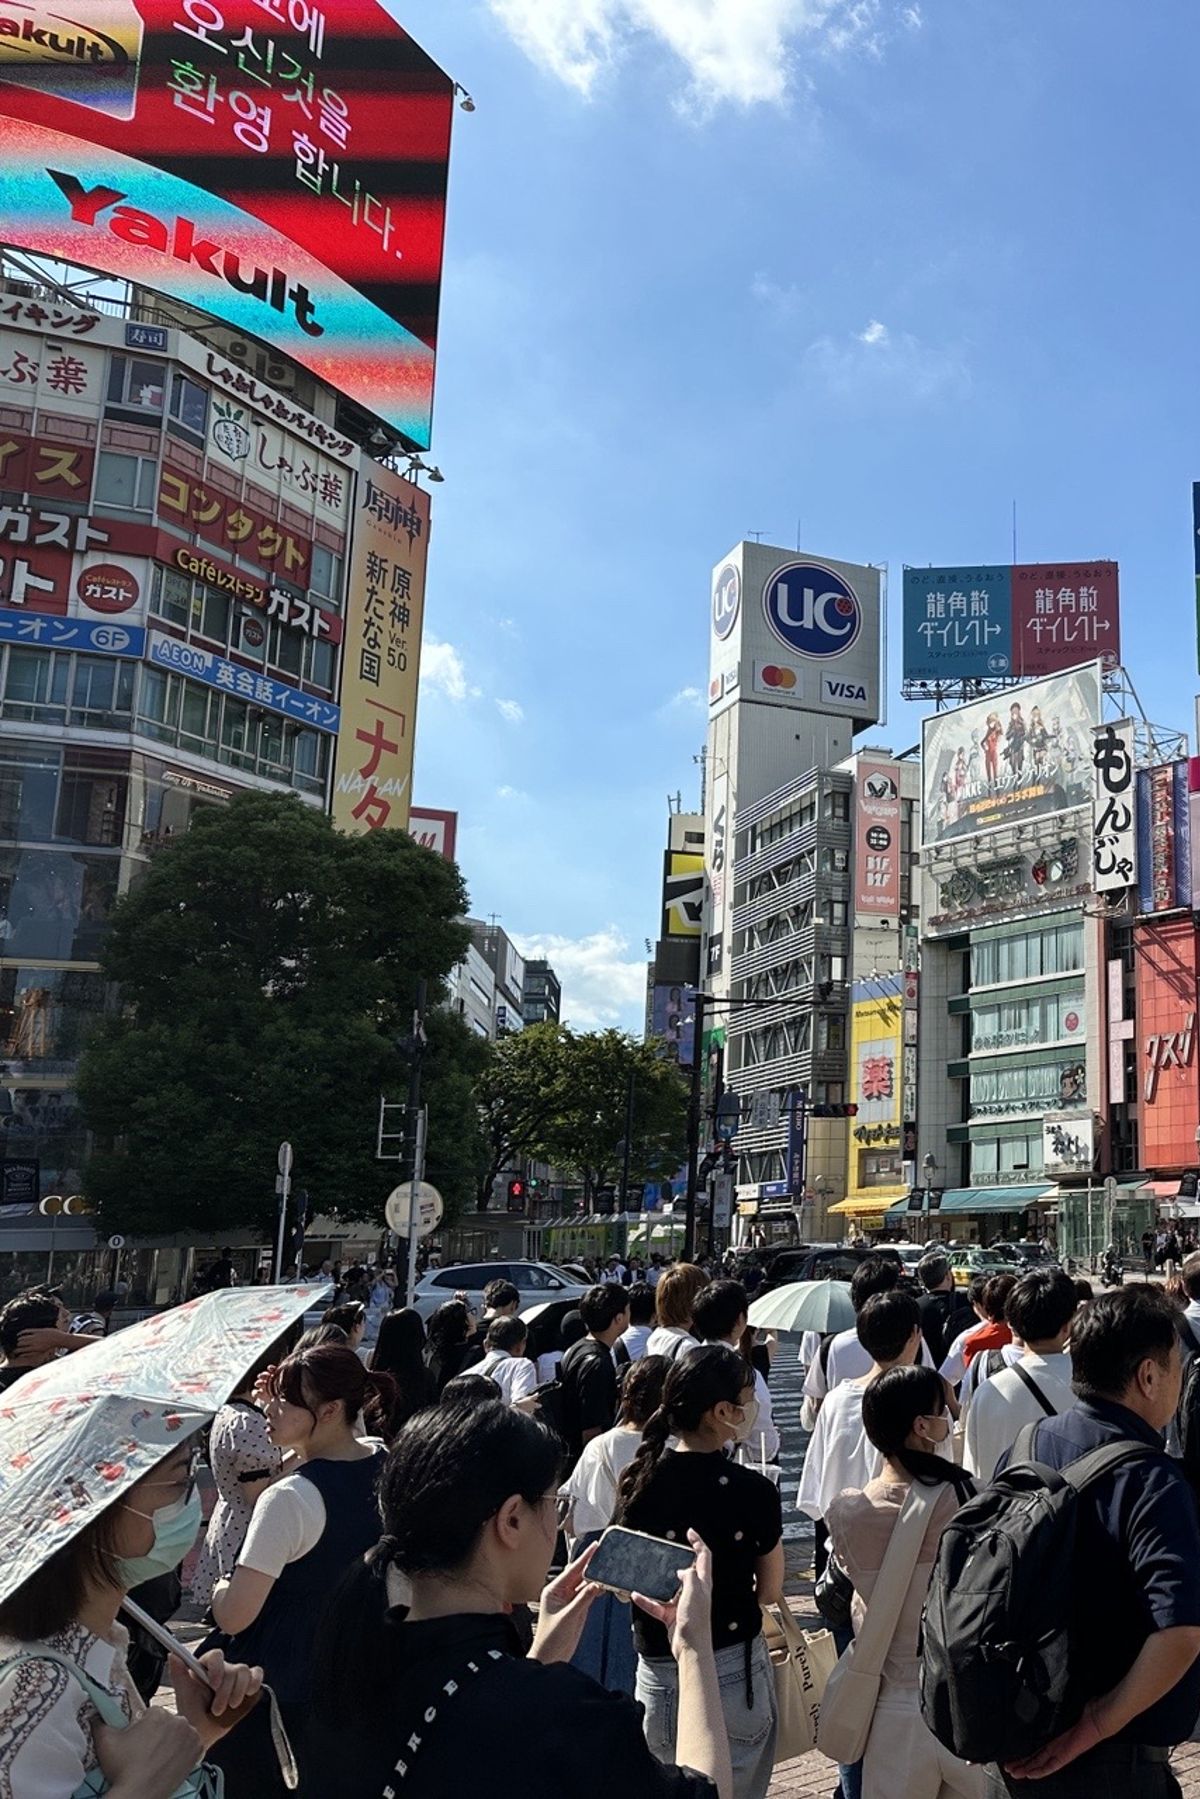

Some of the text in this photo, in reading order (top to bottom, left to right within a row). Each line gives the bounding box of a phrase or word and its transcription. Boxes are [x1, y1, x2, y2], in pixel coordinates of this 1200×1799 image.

[45, 167, 324, 338] Yakult
[131, 329, 164, 346] 寿司
[260, 433, 343, 509] しゃぶ葉
[0, 507, 108, 549] ガスト
[160, 472, 306, 569] コンタクト
[0, 559, 54, 603] ト
[85, 584, 132, 600] ガスト
[389, 565, 412, 634] 原神
[1035, 585, 1098, 614] 龍角散
[267, 587, 331, 638] ガスト
[359, 549, 388, 688] 新たな国
[926, 589, 990, 618] 龍角散
[95, 630, 125, 648] 6F
[918, 619, 1001, 647] ダイレクト
[1026, 616, 1110, 643] ダイレクト
[159, 640, 206, 672] AEON
[387, 649, 407, 673] 5.0
[824, 680, 867, 701] VISA
[1094, 727, 1133, 882] もんじゃ
[710, 944, 721, 962] 7F
[862, 1055, 894, 1100] 薬
[795, 1645, 813, 1692] Purely
